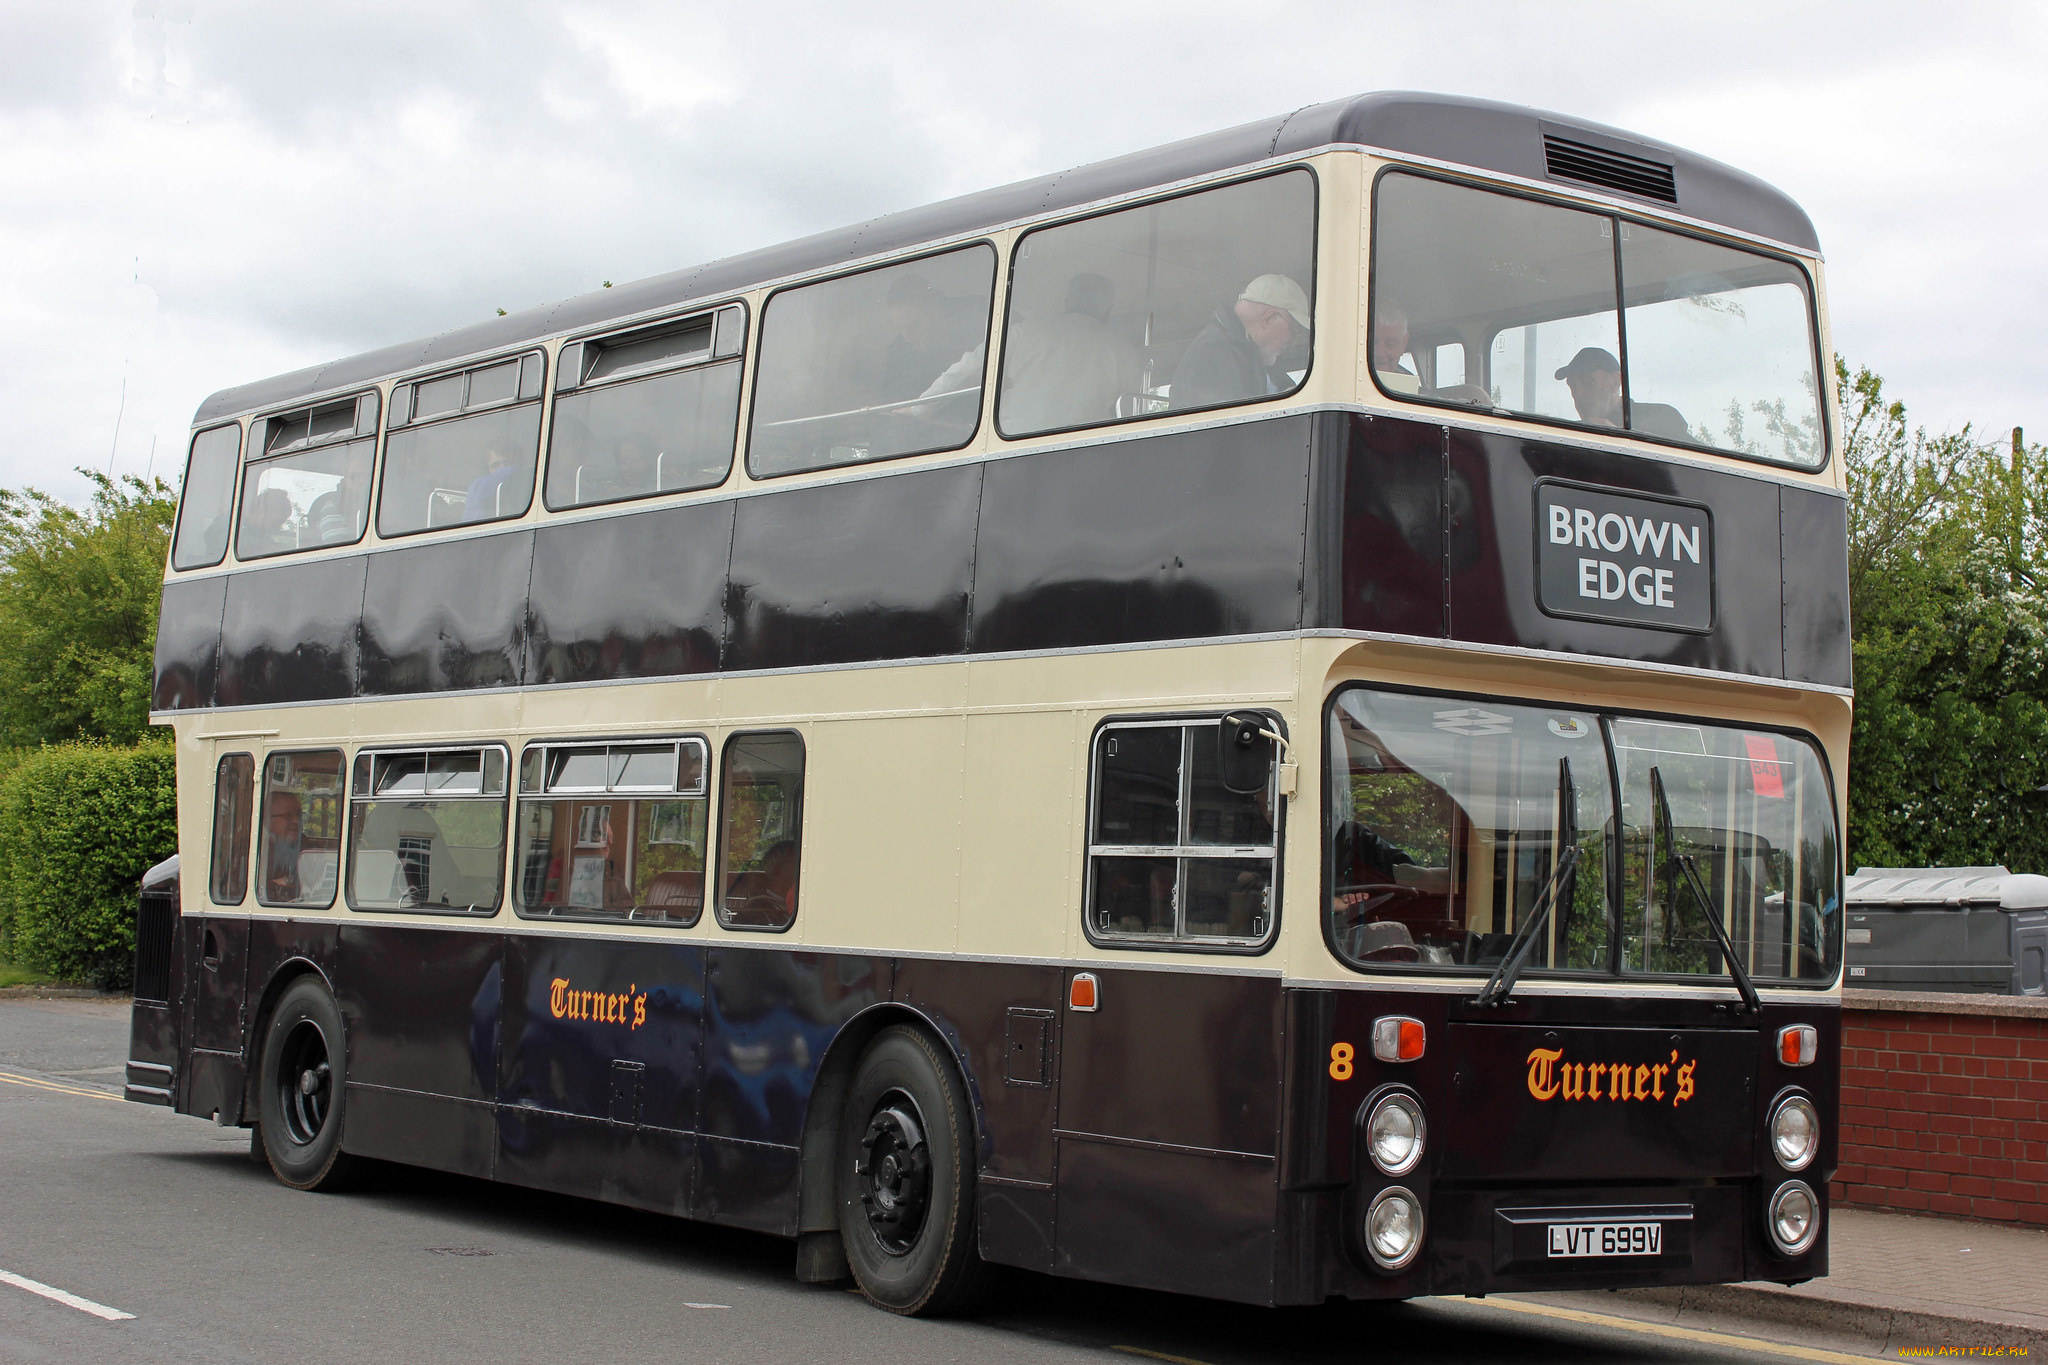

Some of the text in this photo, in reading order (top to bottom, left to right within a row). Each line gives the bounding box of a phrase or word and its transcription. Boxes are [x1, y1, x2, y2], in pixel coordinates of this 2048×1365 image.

[1549, 504, 1700, 564] BROWN
[1579, 557, 1675, 609] EDGE
[550, 977, 647, 1031] Turner's
[1329, 1042, 1355, 1081] 8
[1526, 1047, 1697, 1108] Turner's
[1549, 1226, 1660, 1255] LVT 699V
